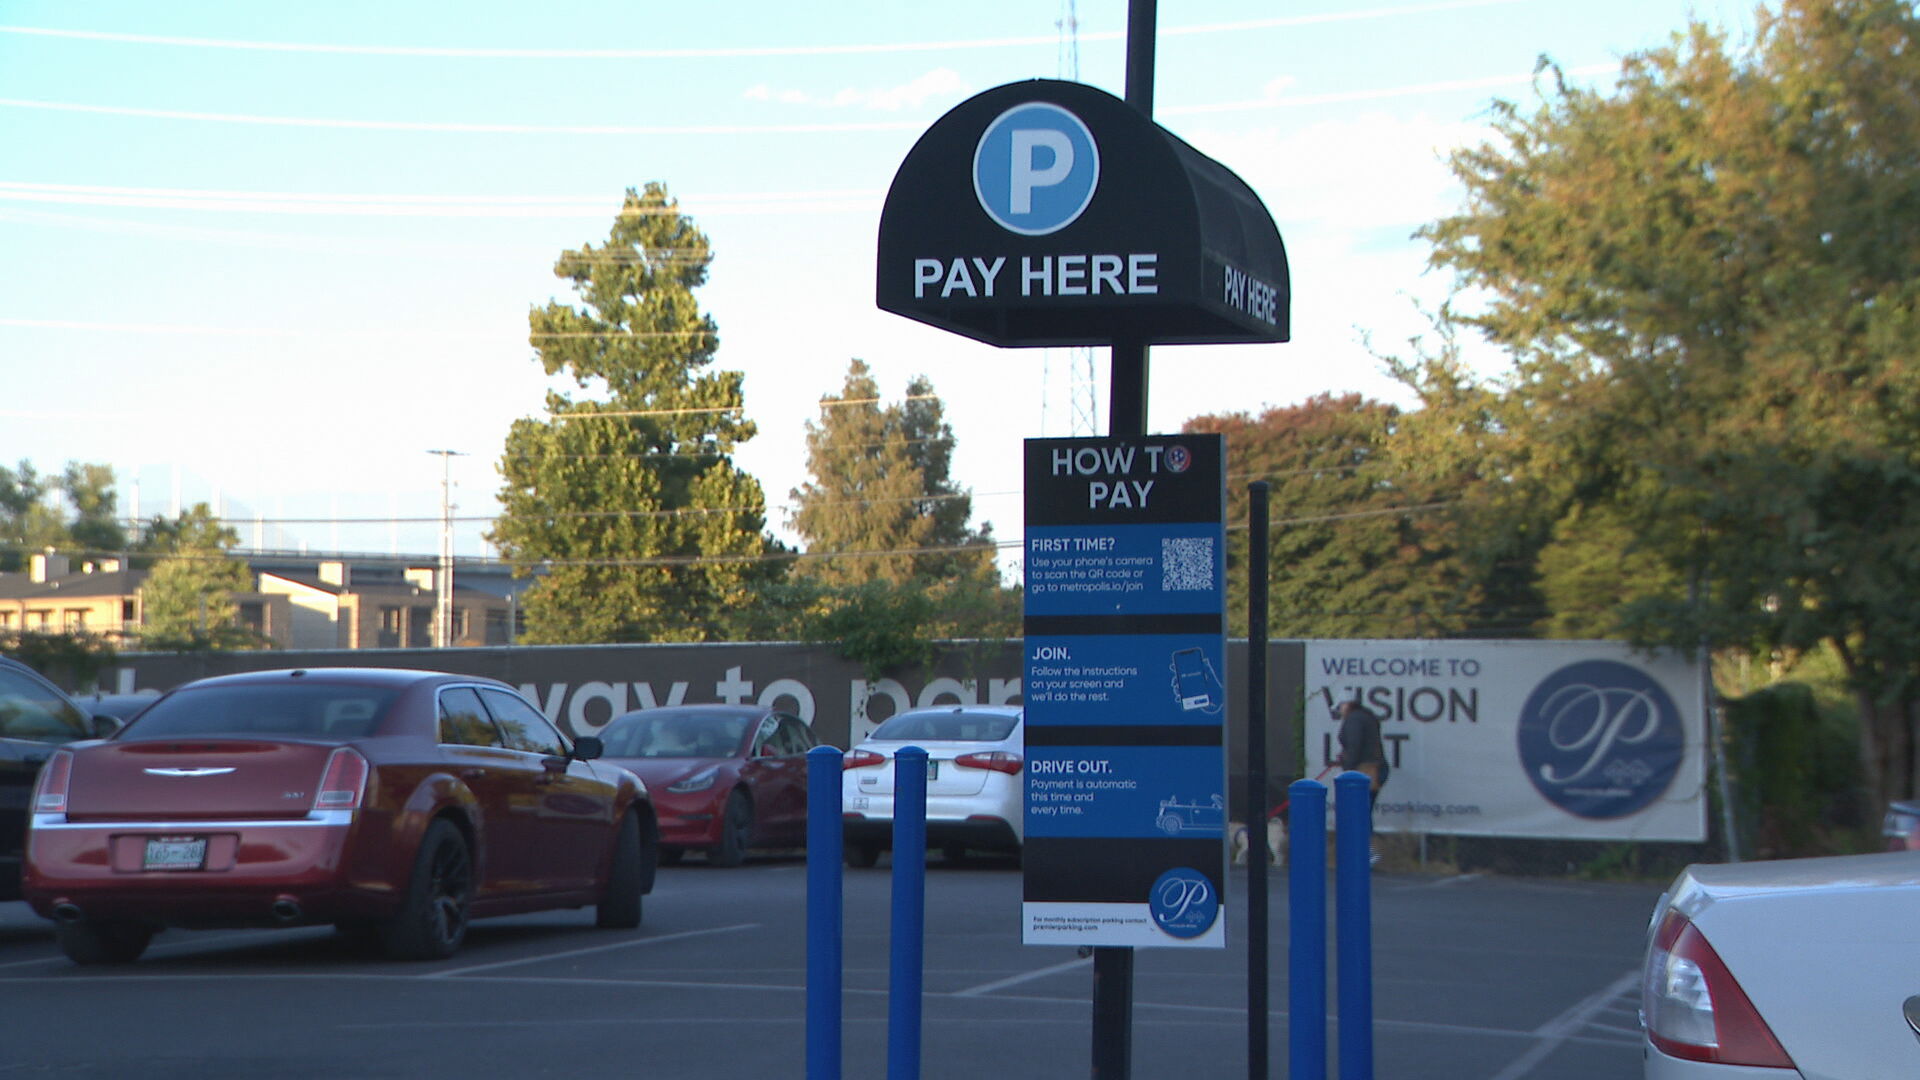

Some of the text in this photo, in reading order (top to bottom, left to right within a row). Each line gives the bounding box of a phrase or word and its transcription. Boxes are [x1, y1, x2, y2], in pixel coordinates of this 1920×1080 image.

[1009, 129, 1075, 214] P
[914, 254, 1159, 298] PAY HERE
[1224, 264, 1277, 325] PAY HERE
[1052, 446, 1191, 476] HOW T
[1089, 480, 1154, 509] PAY
[1031, 537, 1116, 551] FIRST TIME?
[1031, 556, 1153, 570] Use your phone's camera
[1032, 569, 1143, 580] to scan the QR code or
[1032, 581, 1144, 594] go to metropolis.io/join
[1032, 647, 1071, 660] JOIN.
[1031, 666, 1137, 676] Follow the instructions
[1321, 657, 1480, 677] WELCOME TO
[1031, 679, 1124, 691] on your screen and
[715, 665, 816, 728] to
[1031, 692, 1110, 701] we'll do the rest.
[1323, 732, 1410, 769] LT
[1031, 760, 1113, 773] DRIVE OUT.
[1031, 779, 1137, 790] Payment is automatic
[1031, 792, 1094, 801] this time and
[1031, 805, 1084, 816] every time.
